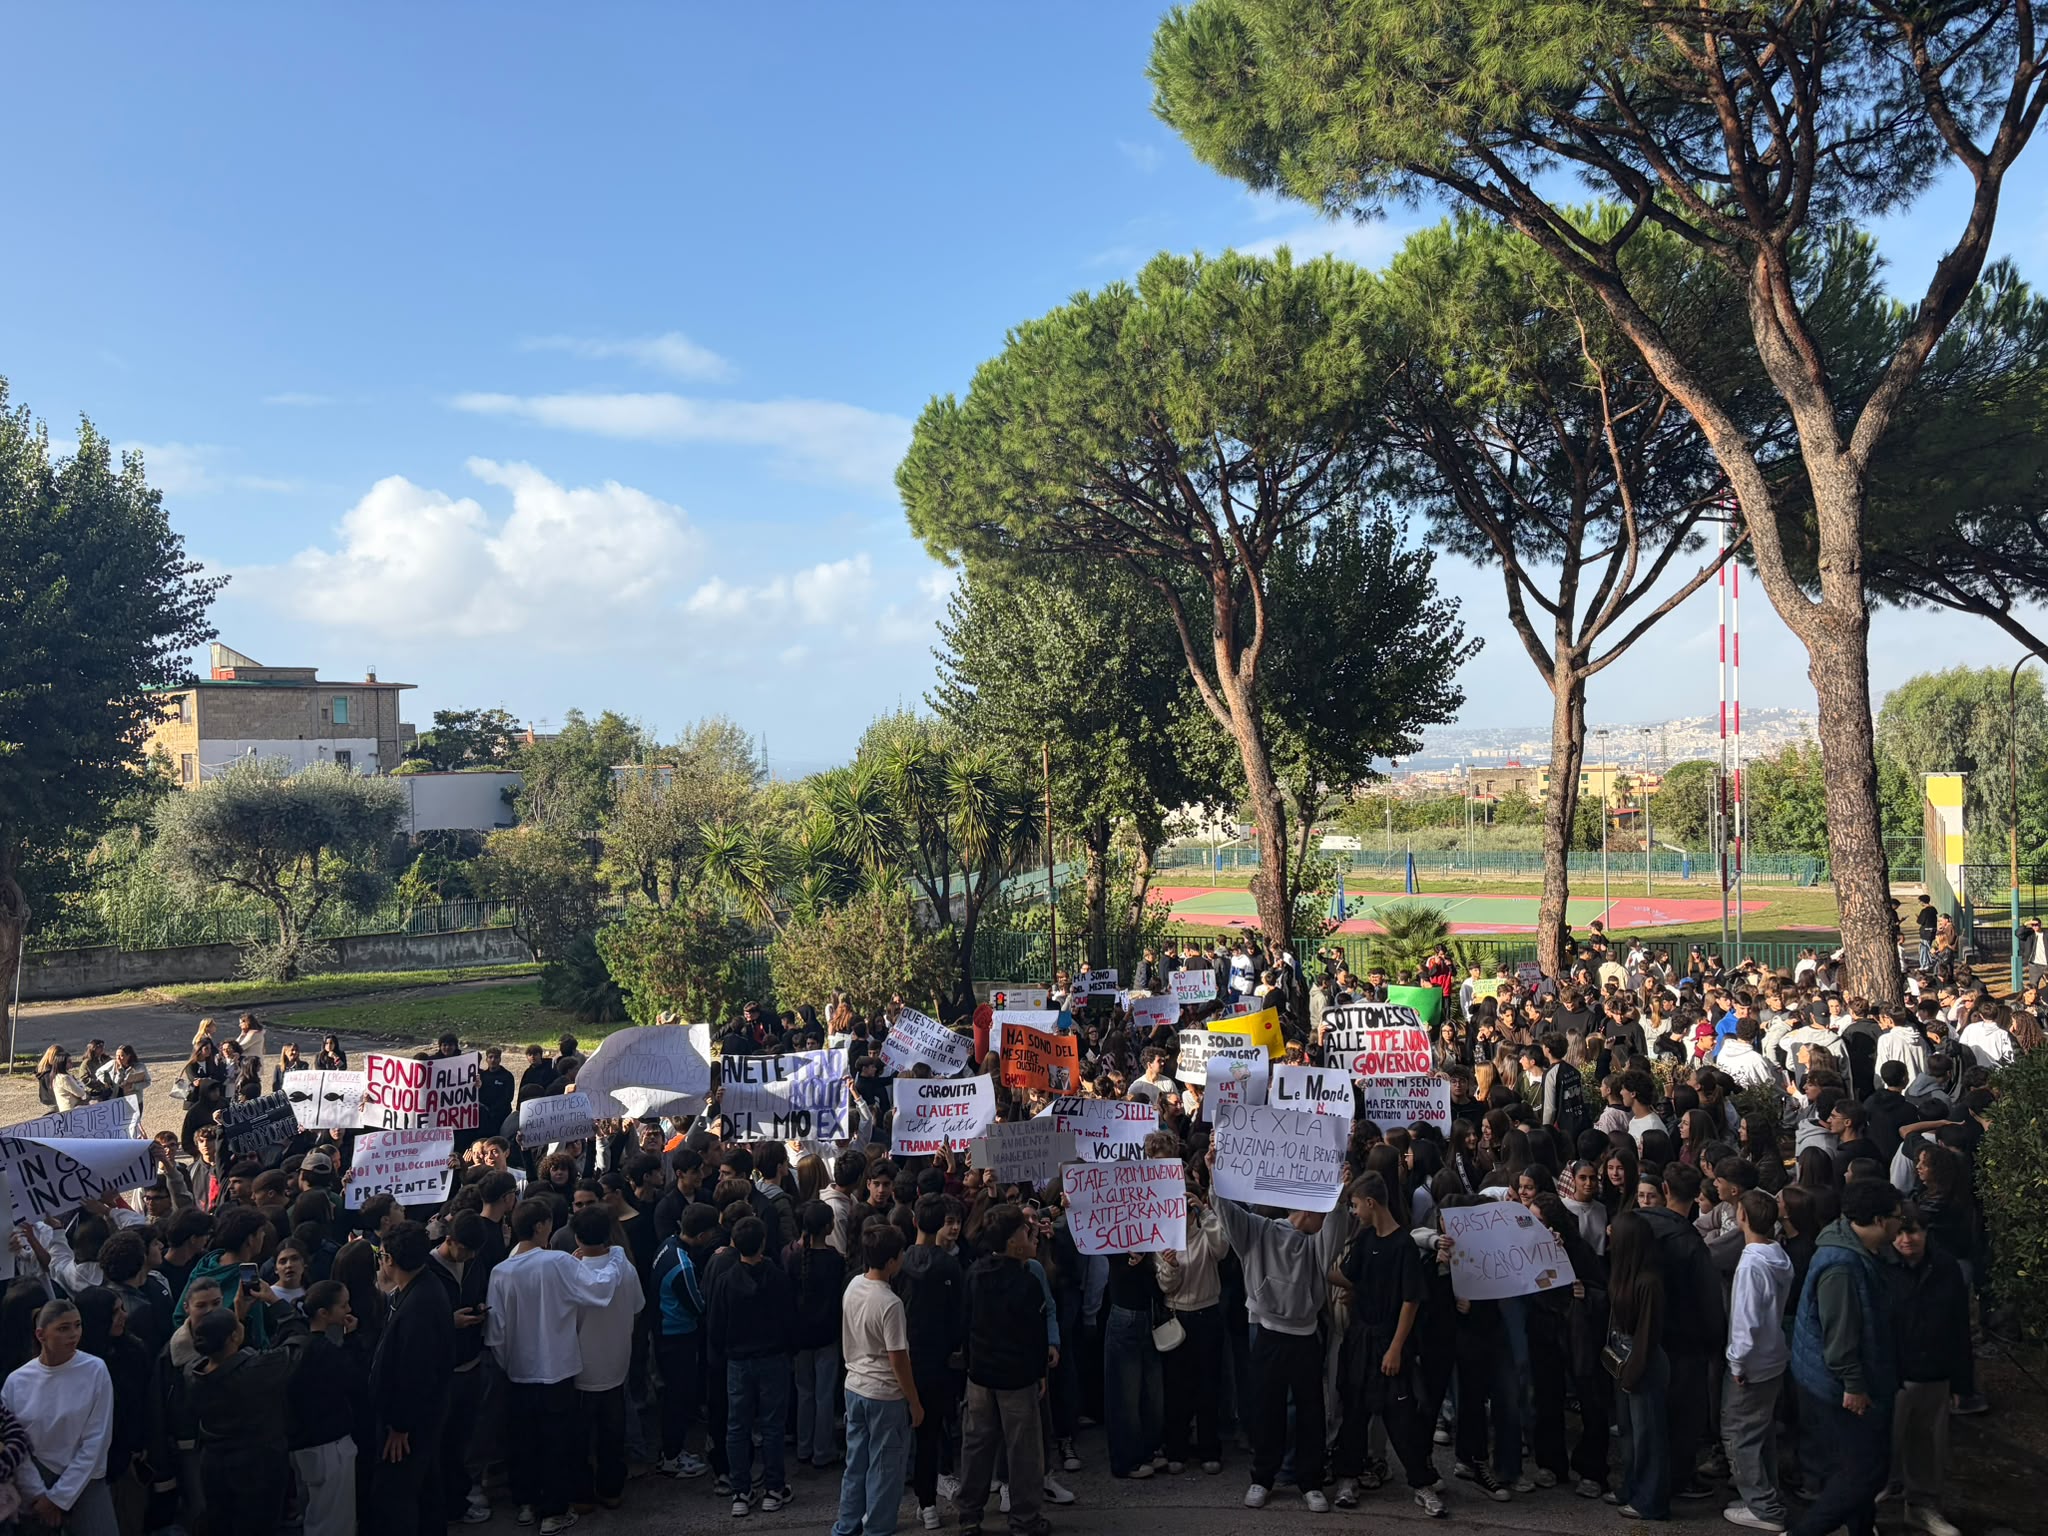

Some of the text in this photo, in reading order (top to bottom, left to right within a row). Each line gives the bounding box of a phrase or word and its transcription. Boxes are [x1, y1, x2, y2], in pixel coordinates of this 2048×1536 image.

[901, 1008, 936, 1031] QUESTA
[1322, 1006, 1420, 1033] SOTTOMESSI
[1028, 1033, 1052, 1055] SONO
[1055, 1044, 1075, 1058] DEL
[1207, 1035, 1244, 1048] SONO
[1326, 1031, 1367, 1053] ALLE
[1001, 1047, 1040, 1065] MESTIERE
[1353, 1052, 1430, 1075] GOVERNO
[368, 1055, 477, 1089] FONDI ALLA
[721, 1054, 788, 1084] AVETE
[918, 1083, 977, 1098] CAROVITA
[1219, 1081, 1235, 1091] EAT
[1278, 1074, 1349, 1102] Le Monde
[1376, 1079, 1394, 1087] NON
[1398, 1079, 1407, 1087] MI
[1411, 1078, 1442, 1087] SENTO
[367, 1082, 477, 1113] SCUOLA NON
[1366, 1099, 1379, 1109] MA
[1381, 1099, 1396, 1109] PER
[1397, 1100, 1433, 1109] FORTUNA
[436, 1103, 479, 1129] ARMI
[550, 1114, 565, 1124] MIA
[916, 1102, 970, 1117] CI AVETE
[1114, 1102, 1157, 1121] STELLE
[1407, 1111, 1416, 1120] LO
[1418, 1110, 1446, 1120] SONO
[719, 1107, 846, 1142] DEL MIO EX
[1219, 1104, 1263, 1133] 50€
[1295, 1114, 1323, 1138] LA
[356, 1133, 377, 1152] SE
[382, 1132, 397, 1147] CI
[545, 1130, 557, 1140] AL
[899, 1139, 942, 1152] TRANNE
[1093, 1142, 1147, 1161] VOGLIAM
[1300, 1144, 1312, 1162] AL
[375, 1163, 389, 1175] VI
[1231, 1157, 1254, 1177] 40
[1256, 1160, 1285, 1178] ALLA
[1065, 1164, 1185, 1195] STATE PROMUOVENDO
[1092, 1186, 1158, 1205] LA GUERRA
[1074, 1197, 1186, 1232] E ATTERRANDO
[1450, 1209, 1508, 1237] BASTA
[1095, 1222, 1165, 1250] SCUOLA
